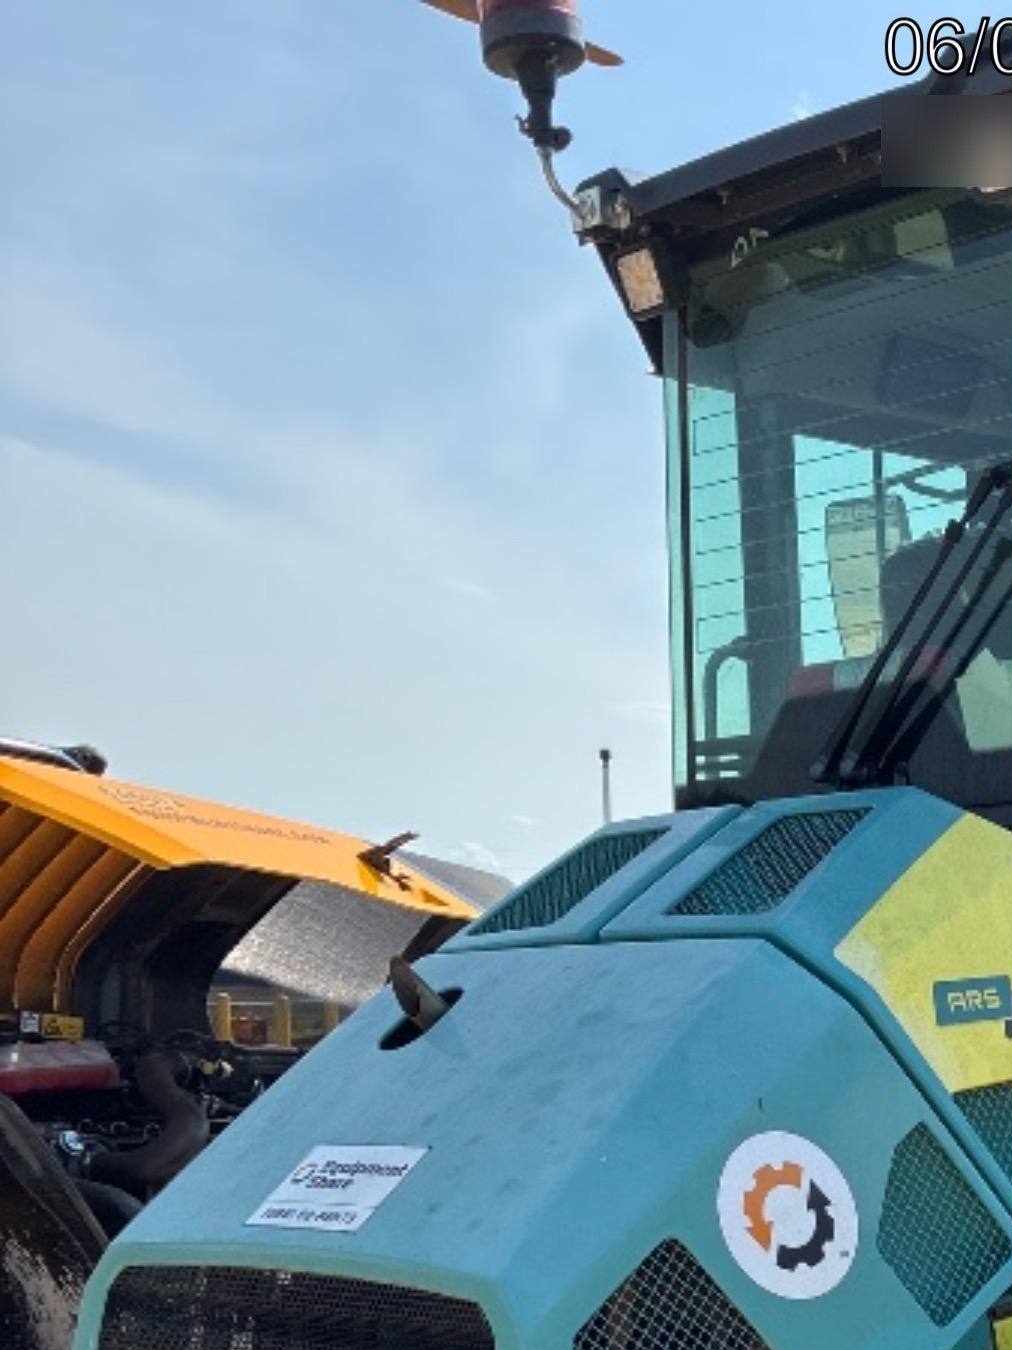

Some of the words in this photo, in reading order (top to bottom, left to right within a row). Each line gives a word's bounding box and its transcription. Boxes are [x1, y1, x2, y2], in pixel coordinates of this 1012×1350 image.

[948, 988, 1001, 1012] ARS
[321, 1161, 409, 1177] Equipment
[305, 1177, 354, 1189] Share
